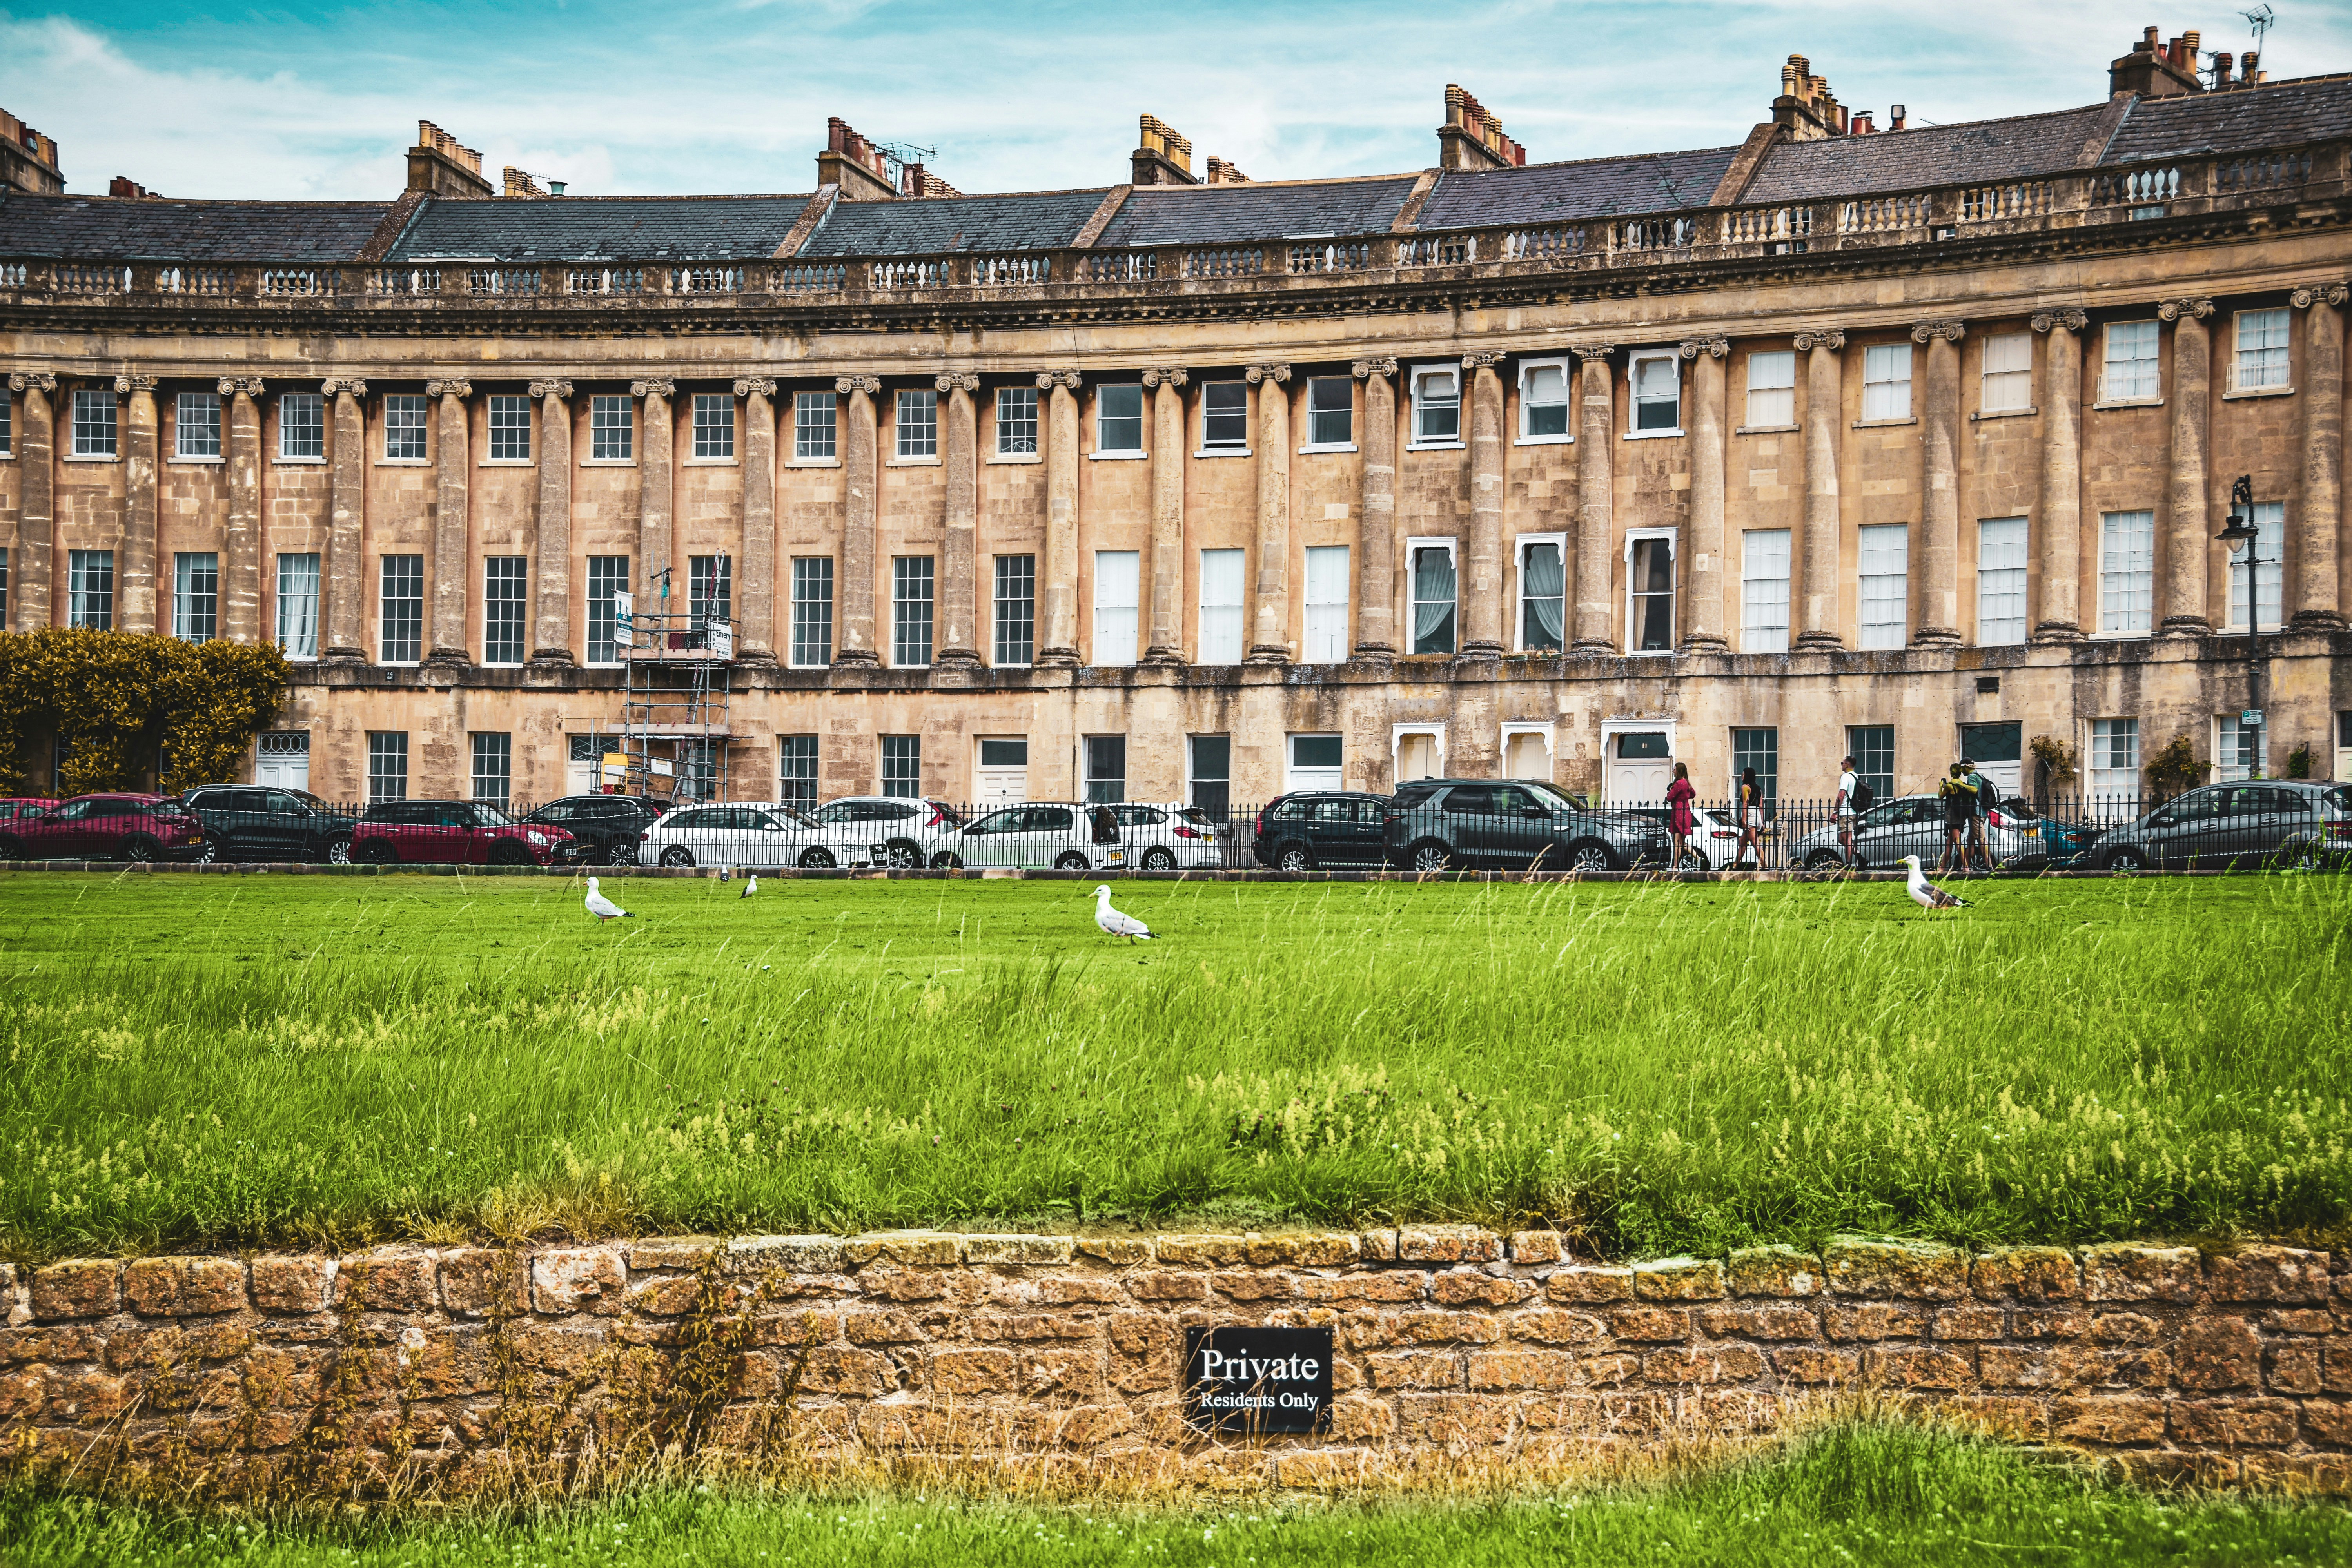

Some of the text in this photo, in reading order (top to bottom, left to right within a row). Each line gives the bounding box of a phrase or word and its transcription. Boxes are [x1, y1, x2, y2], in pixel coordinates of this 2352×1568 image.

[716, 629, 730, 642] Emery
[1200, 1348, 1319, 1380] Private
[1200, 1392, 1319, 1411] Residents Only
